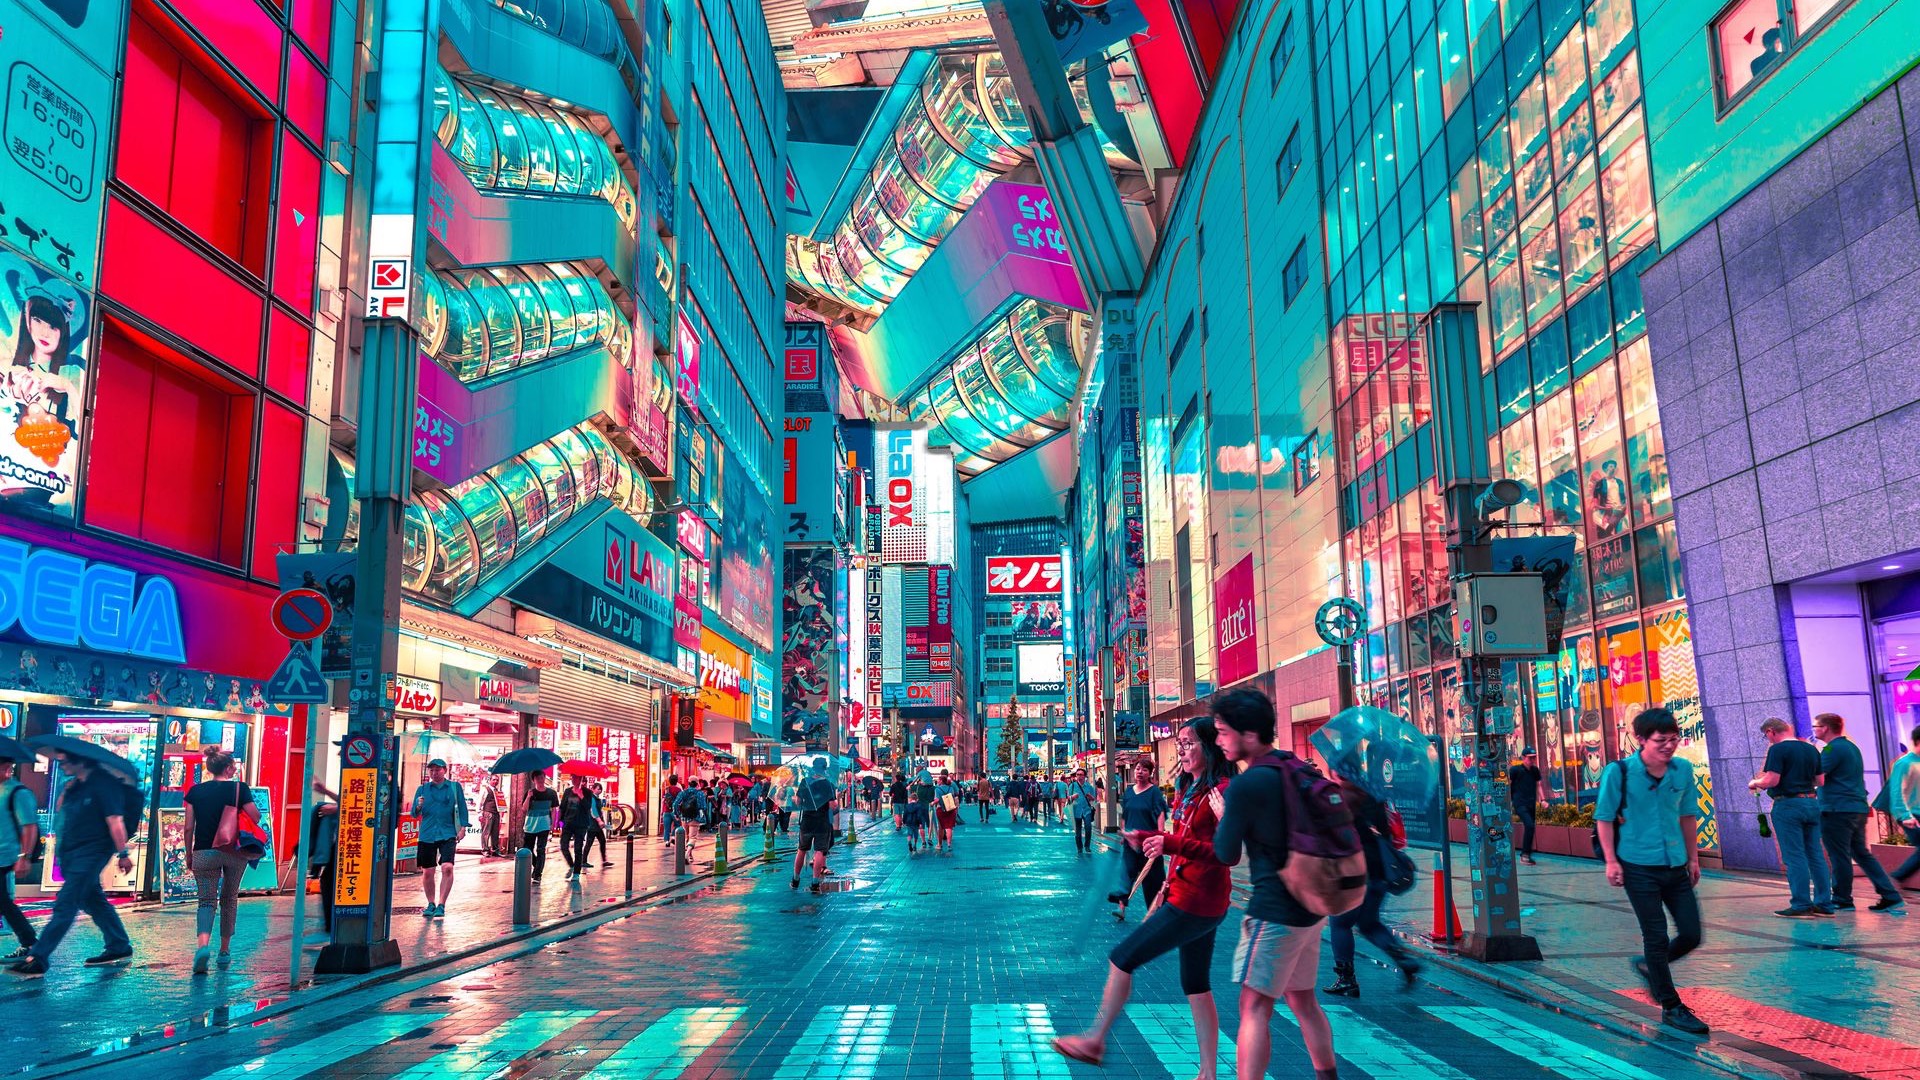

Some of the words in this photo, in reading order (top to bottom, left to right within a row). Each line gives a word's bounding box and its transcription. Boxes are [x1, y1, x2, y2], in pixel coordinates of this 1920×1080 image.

[19, 90, 85, 150] 16:00
[26, 74, 84, 127] 営業時間
[13, 134, 84, 195] 翌5:00
[415, 406, 454, 447] カメラ
[415, 438, 442, 467] メラ
[630, 539, 672, 602] LABI
[936, 569, 949, 597] Duty
[589, 596, 642, 645] パソコン館
[628, 588, 672, 622] AKIHABARA
[937, 598, 950, 625] Free
[491, 679, 514, 698] LABI
[1029, 684, 1059, 692] TOKYO
[365, 773, 375, 813] 千代田区内は
[345, 778, 365, 901] 路上喫煙禁止です。
[402, 821, 419, 834] au
